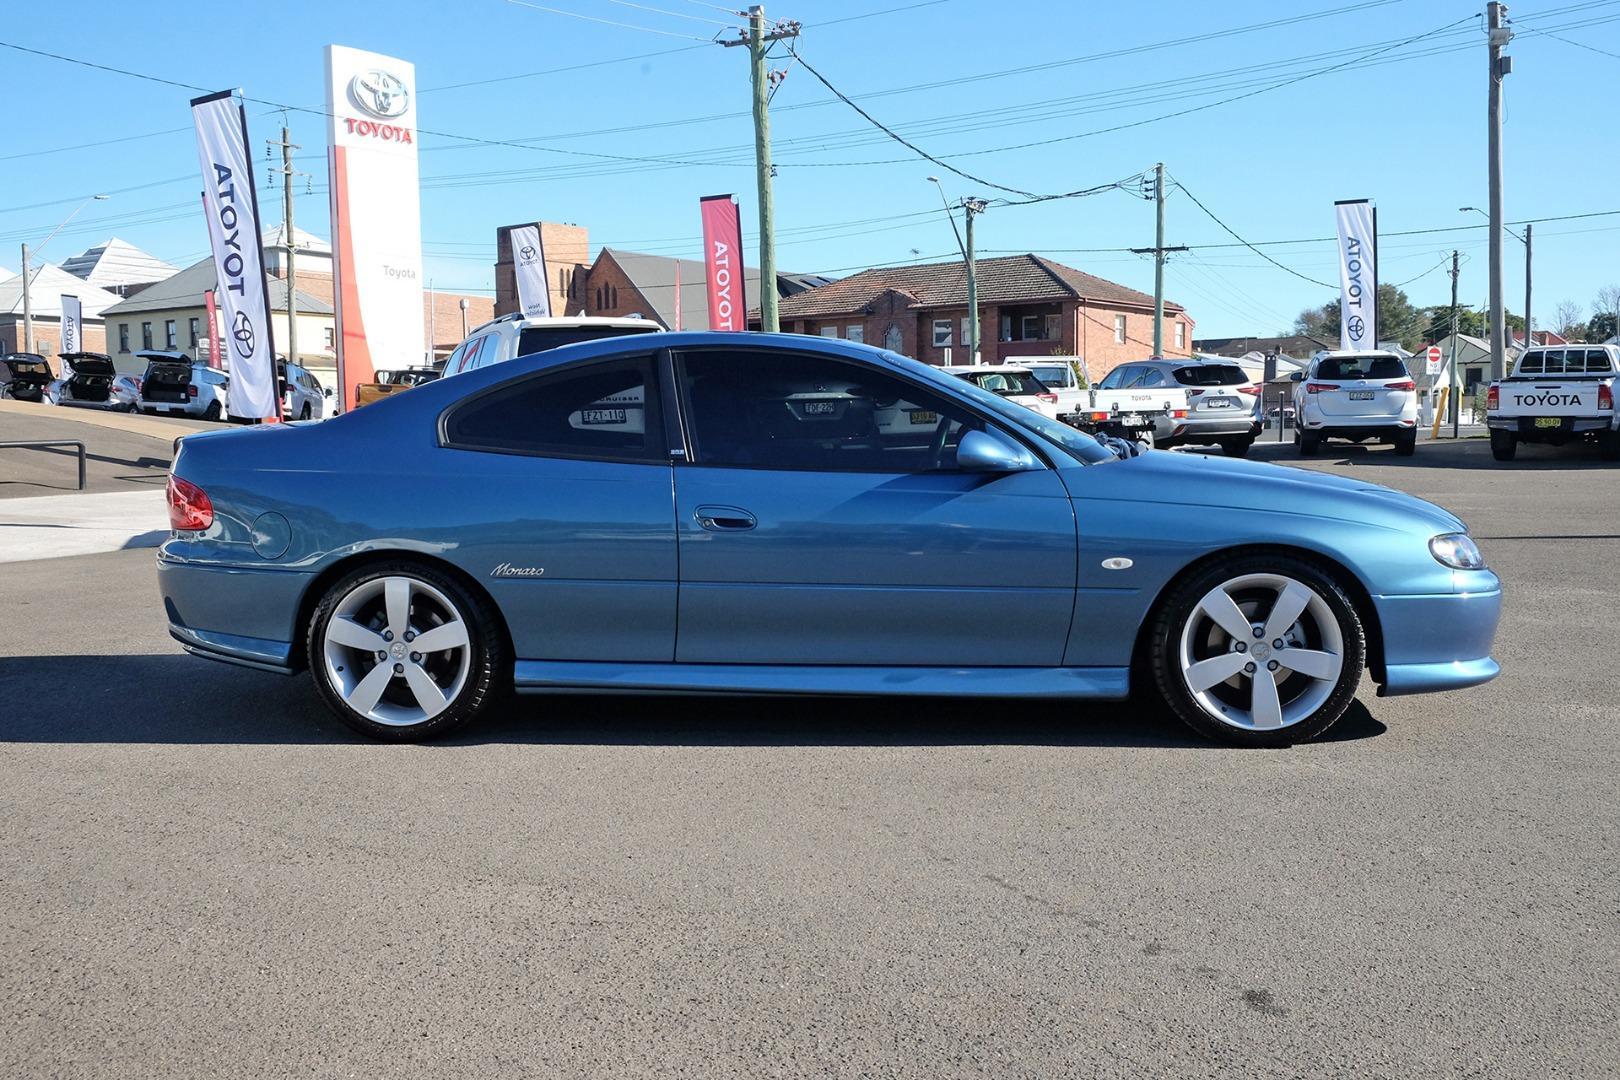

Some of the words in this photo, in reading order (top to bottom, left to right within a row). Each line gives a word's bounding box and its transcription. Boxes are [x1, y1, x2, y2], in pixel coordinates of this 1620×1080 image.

[344, 117, 412, 144] TOYOTA
[383, 265, 416, 280] Toyota
[1514, 394, 1582, 406] TOYOTA
[490, 562, 545, 576] Monaro
